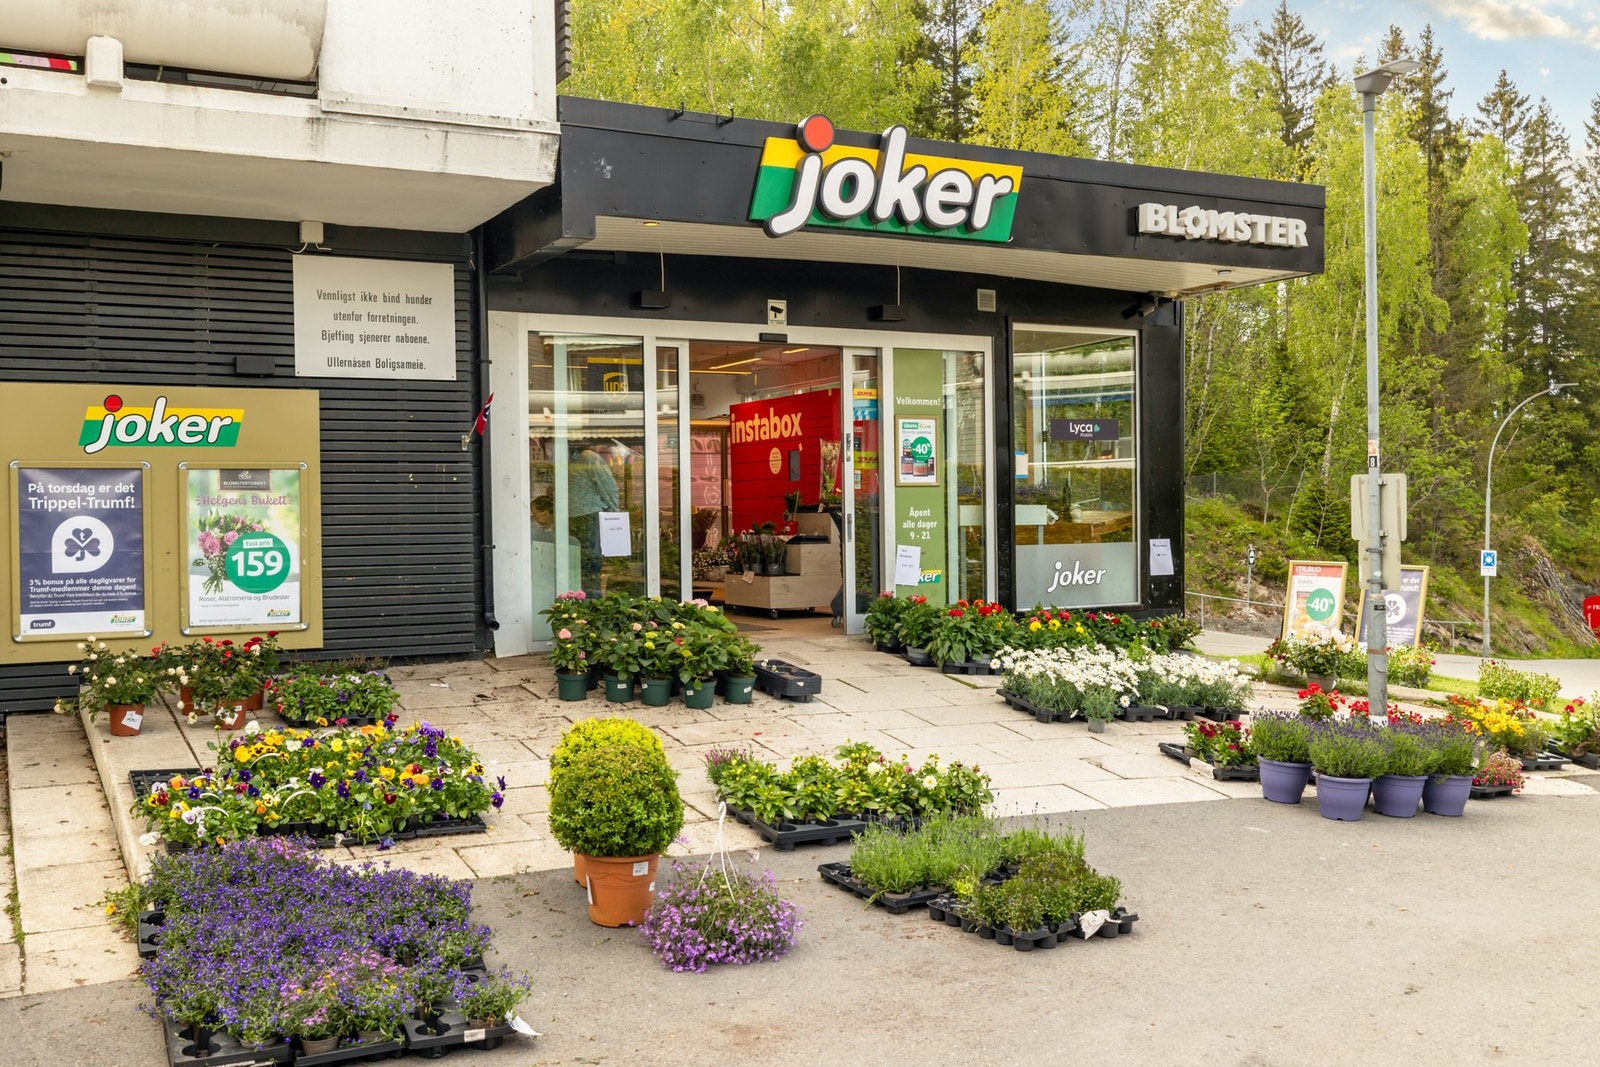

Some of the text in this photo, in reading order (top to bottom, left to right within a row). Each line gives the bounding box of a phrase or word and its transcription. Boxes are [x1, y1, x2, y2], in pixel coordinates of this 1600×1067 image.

[764, 113, 1014, 238] joker
[317, 289, 432, 305] Vennligst ikke bind hunder
[334, 311, 419, 326] utenfor forretningen.
[322, 330, 430, 344] Bjeffing sjenerer naboene.
[327, 356, 426, 371] Ullernåsen Boligsameie.
[896, 396, 940, 406] Velkommen!
[84, 394, 234, 454] joker
[731, 407, 802, 444] instabox
[1070, 422, 1093, 434] Lyca
[1371, 458, 1375, 466] 8
[28, 482, 135, 495] På torsdag er det
[28, 496, 135, 512] Trippel-Trumf!
[202, 495, 288, 506] Helgens Bukett
[909, 506, 931, 518] Åpent
[903, 520, 937, 529] alle dager
[232, 550, 283, 576] 159
[89, 577, 125, 585] dagligvarer
[918, 568, 939, 583] ker
[1047, 561, 1106, 592] joker
[1400, 584, 1419, 592] rumf!
